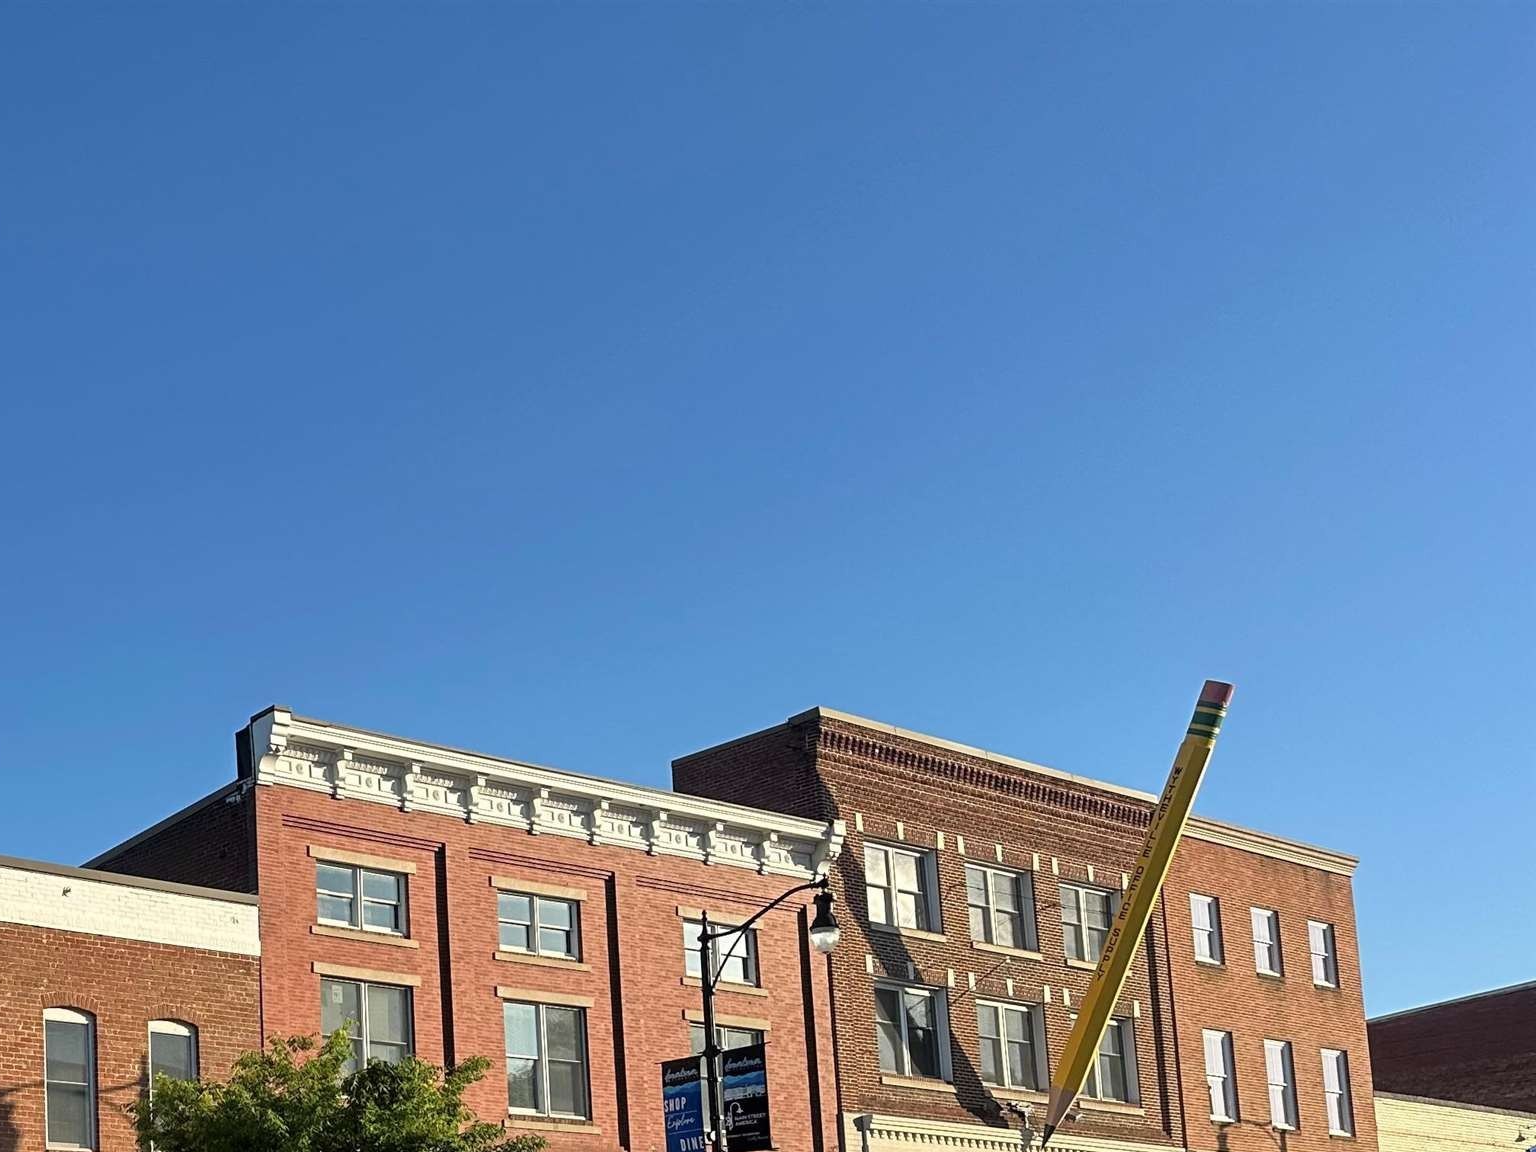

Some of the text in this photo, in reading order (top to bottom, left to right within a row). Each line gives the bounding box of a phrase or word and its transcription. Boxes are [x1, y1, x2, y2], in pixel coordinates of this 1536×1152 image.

[1096, 766, 1183, 981] WYTHEVILLE OFFICE SUPPLY
[664, 1096, 687, 1113] SHOP
[680, 1135, 705, 1152] DINE
